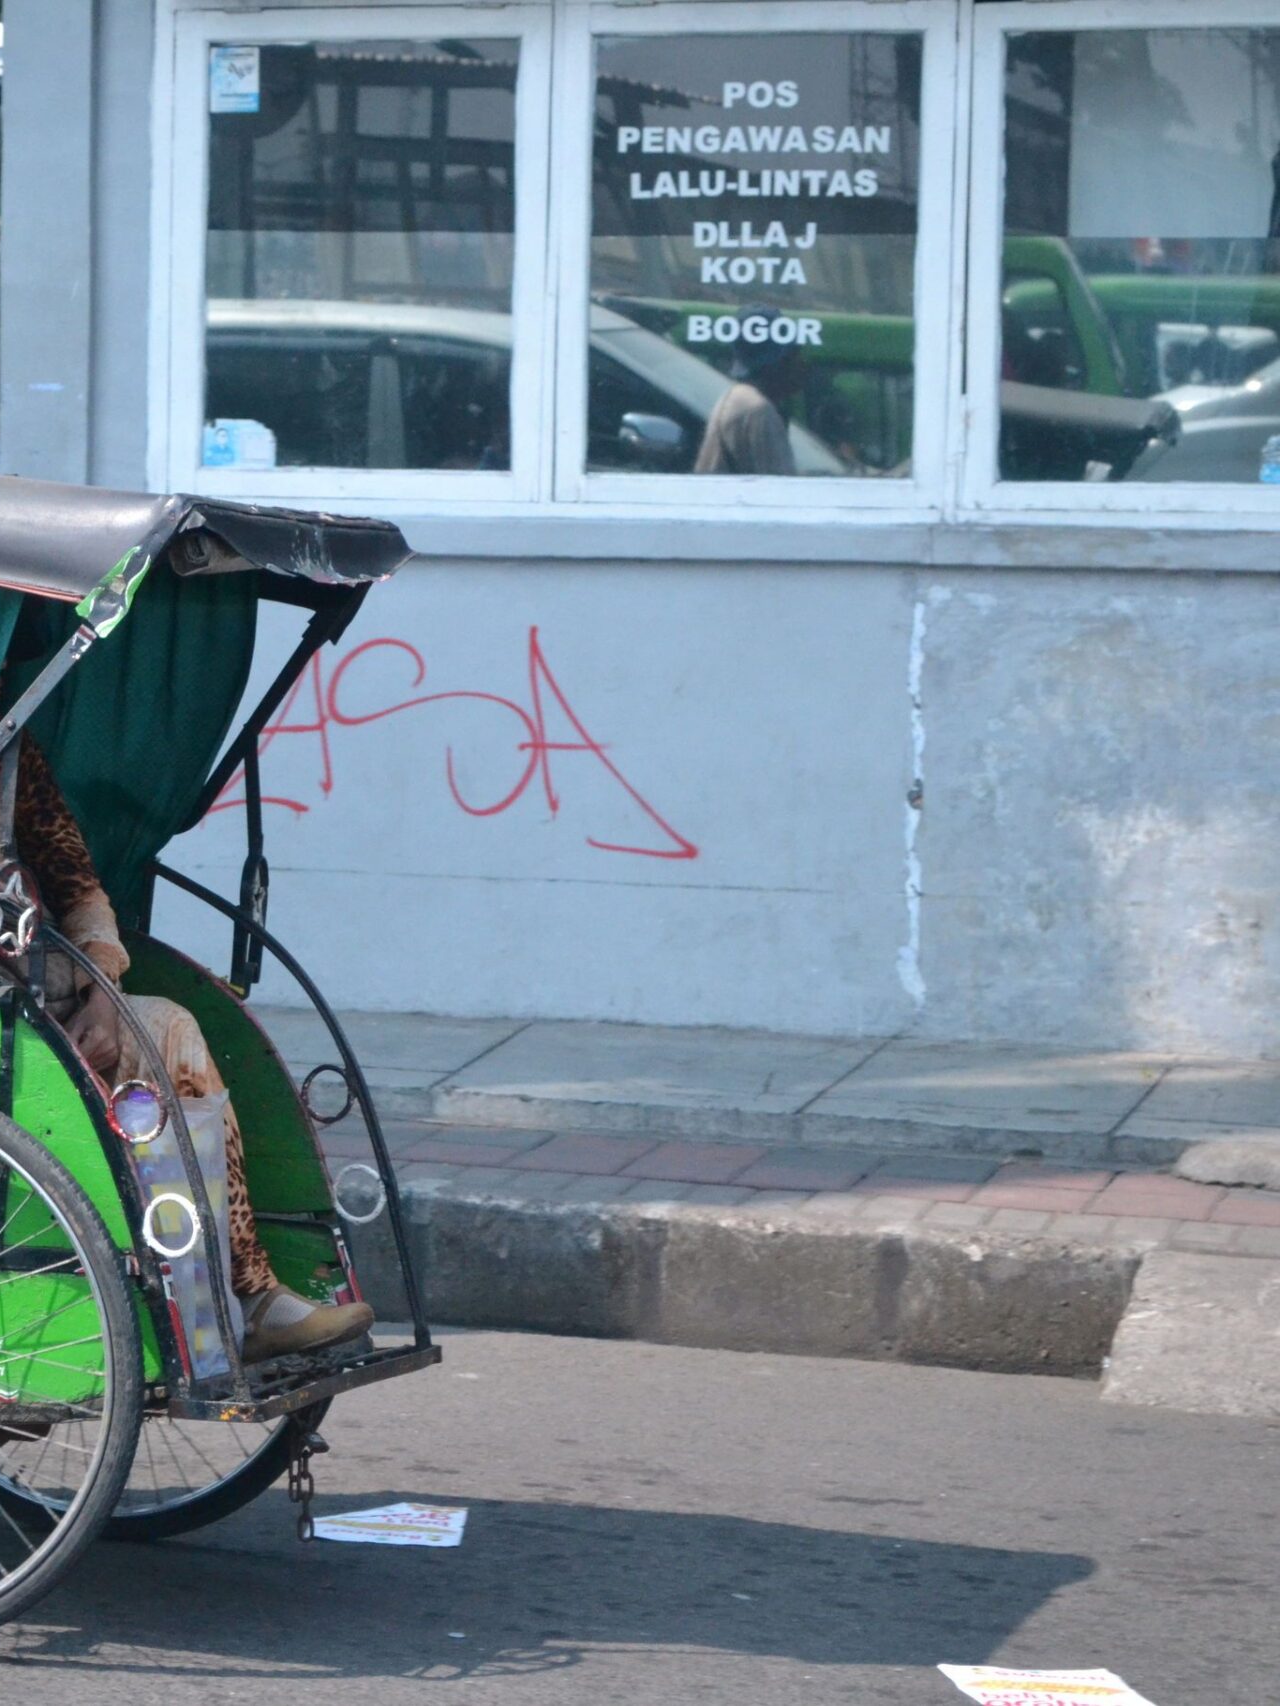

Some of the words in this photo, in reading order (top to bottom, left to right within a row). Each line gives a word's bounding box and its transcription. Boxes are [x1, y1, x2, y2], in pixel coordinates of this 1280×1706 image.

[722, 81, 800, 108] POS
[617, 125, 891, 153] PENGAWASAN
[630, 169, 879, 199] LALU-LINTAS
[700, 256, 807, 285] KOTA
[687, 315, 822, 345] BOGOR
